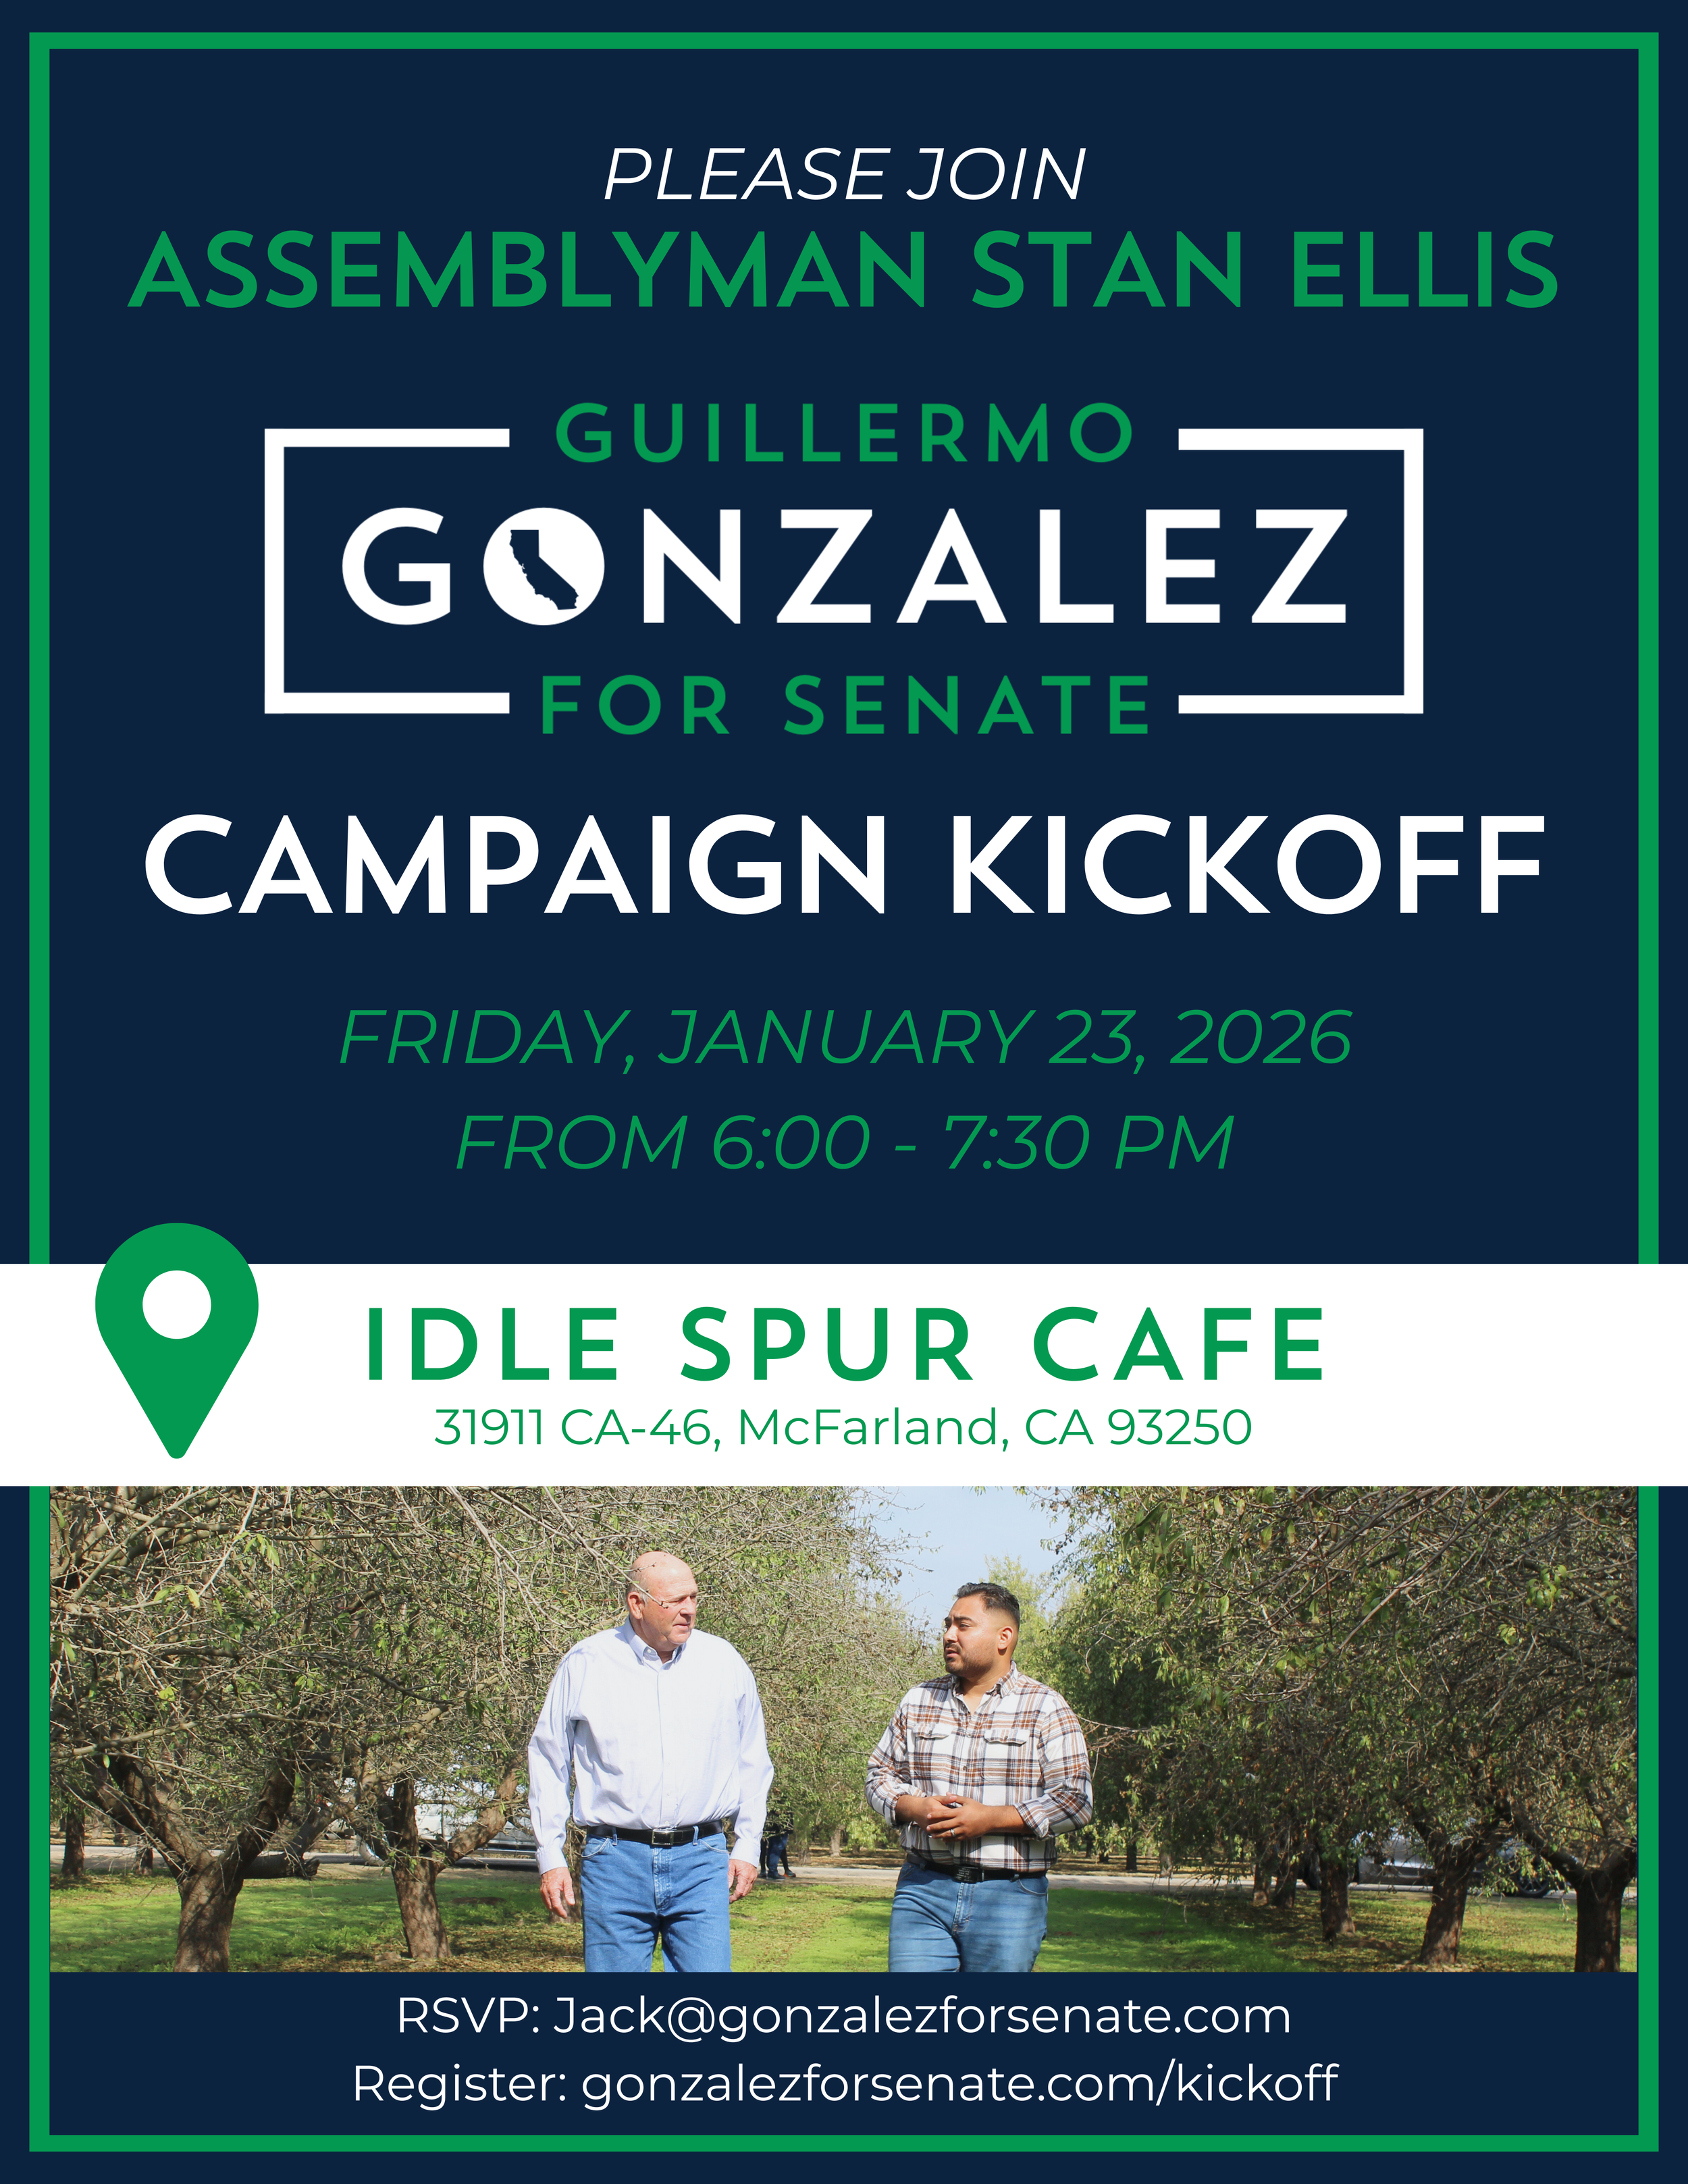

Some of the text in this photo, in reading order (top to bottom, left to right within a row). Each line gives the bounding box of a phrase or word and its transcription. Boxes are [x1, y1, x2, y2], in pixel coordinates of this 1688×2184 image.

[604, 147, 1086, 200] PLEASE JOIN
[128, 231, 1557, 308] ASSEMBLYMAN STAN ELLIS
[556, 403, 1132, 462] GUILLERMO
[543, 675, 1147, 735] FOR SENATE
[145, 814, 1544, 915] CAMPAIGN KICKOFF
[340, 1010, 1352, 1074] FRIDAY, JANUARY 23, 2026
[457, 1115, 687, 1169] FROM
[714, 1115, 869, 1169] 6:00
[946, 1115, 1089, 1169] 7:30
[1115, 1116, 1234, 1169] PM
[369, 1306, 1322, 1381] IDLE SPUR CAFE
[435, 1407, 1251, 1451] 31911 CA-46, McFarland, CA 93250
[400, 1995, 1289, 2043] RSVP: Jack@gonzalezforsenate.com
[356, 2058, 1340, 2110] Register: gonzalezforsenate.com/kickoff
